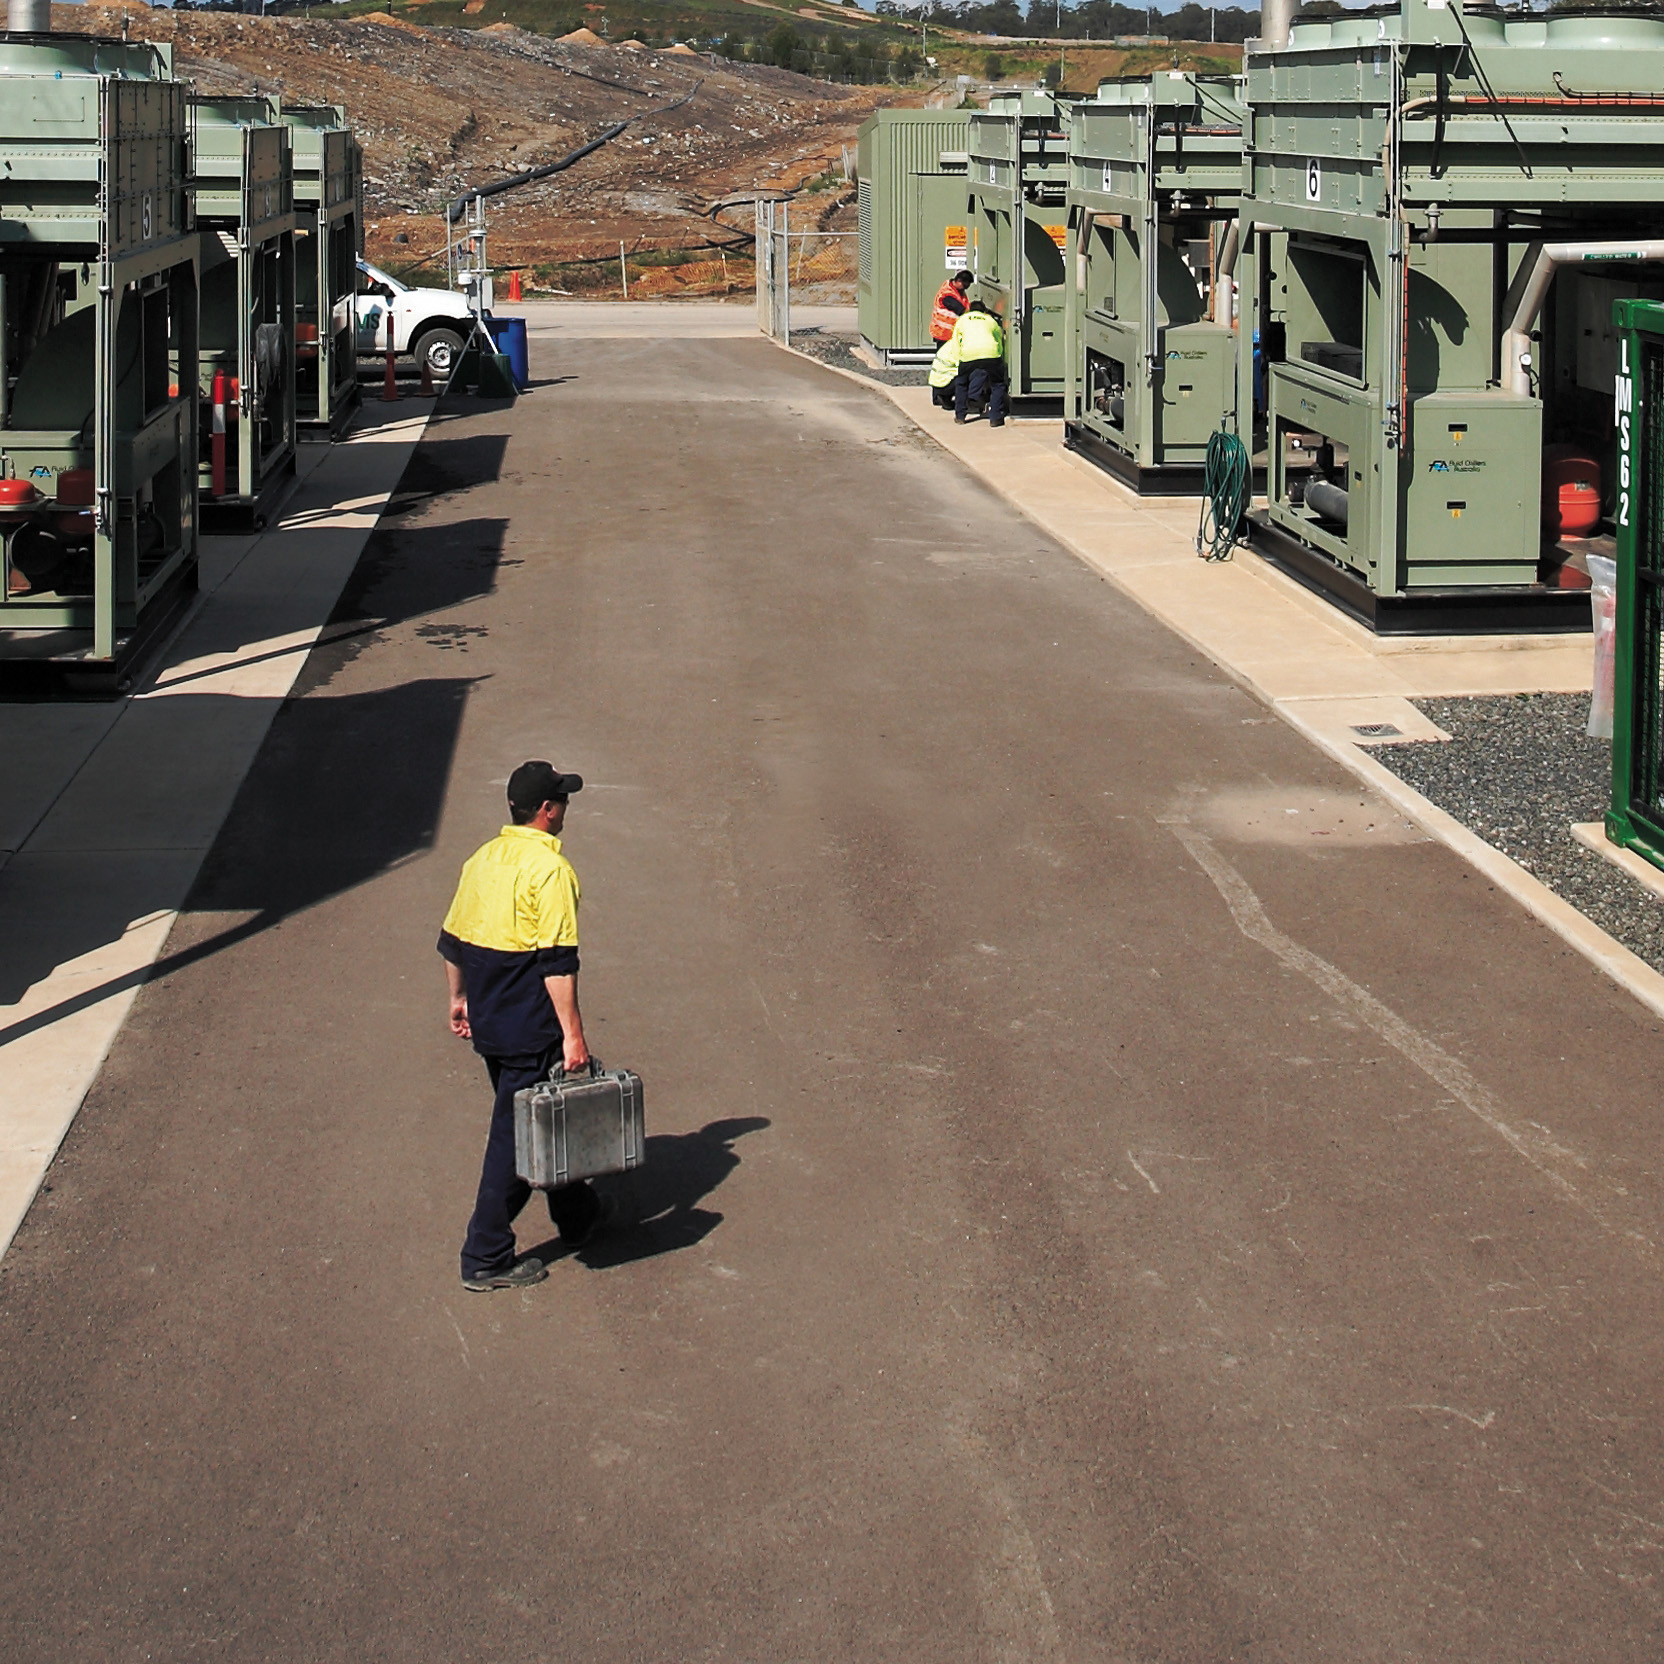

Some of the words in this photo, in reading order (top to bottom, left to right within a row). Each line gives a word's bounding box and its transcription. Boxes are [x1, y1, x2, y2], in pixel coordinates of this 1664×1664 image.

[1309, 159, 1318, 197] 6
[142, 194, 150, 235] 5
[356, 312, 381, 330] MS
[1618, 338, 1633, 527] LMS62
